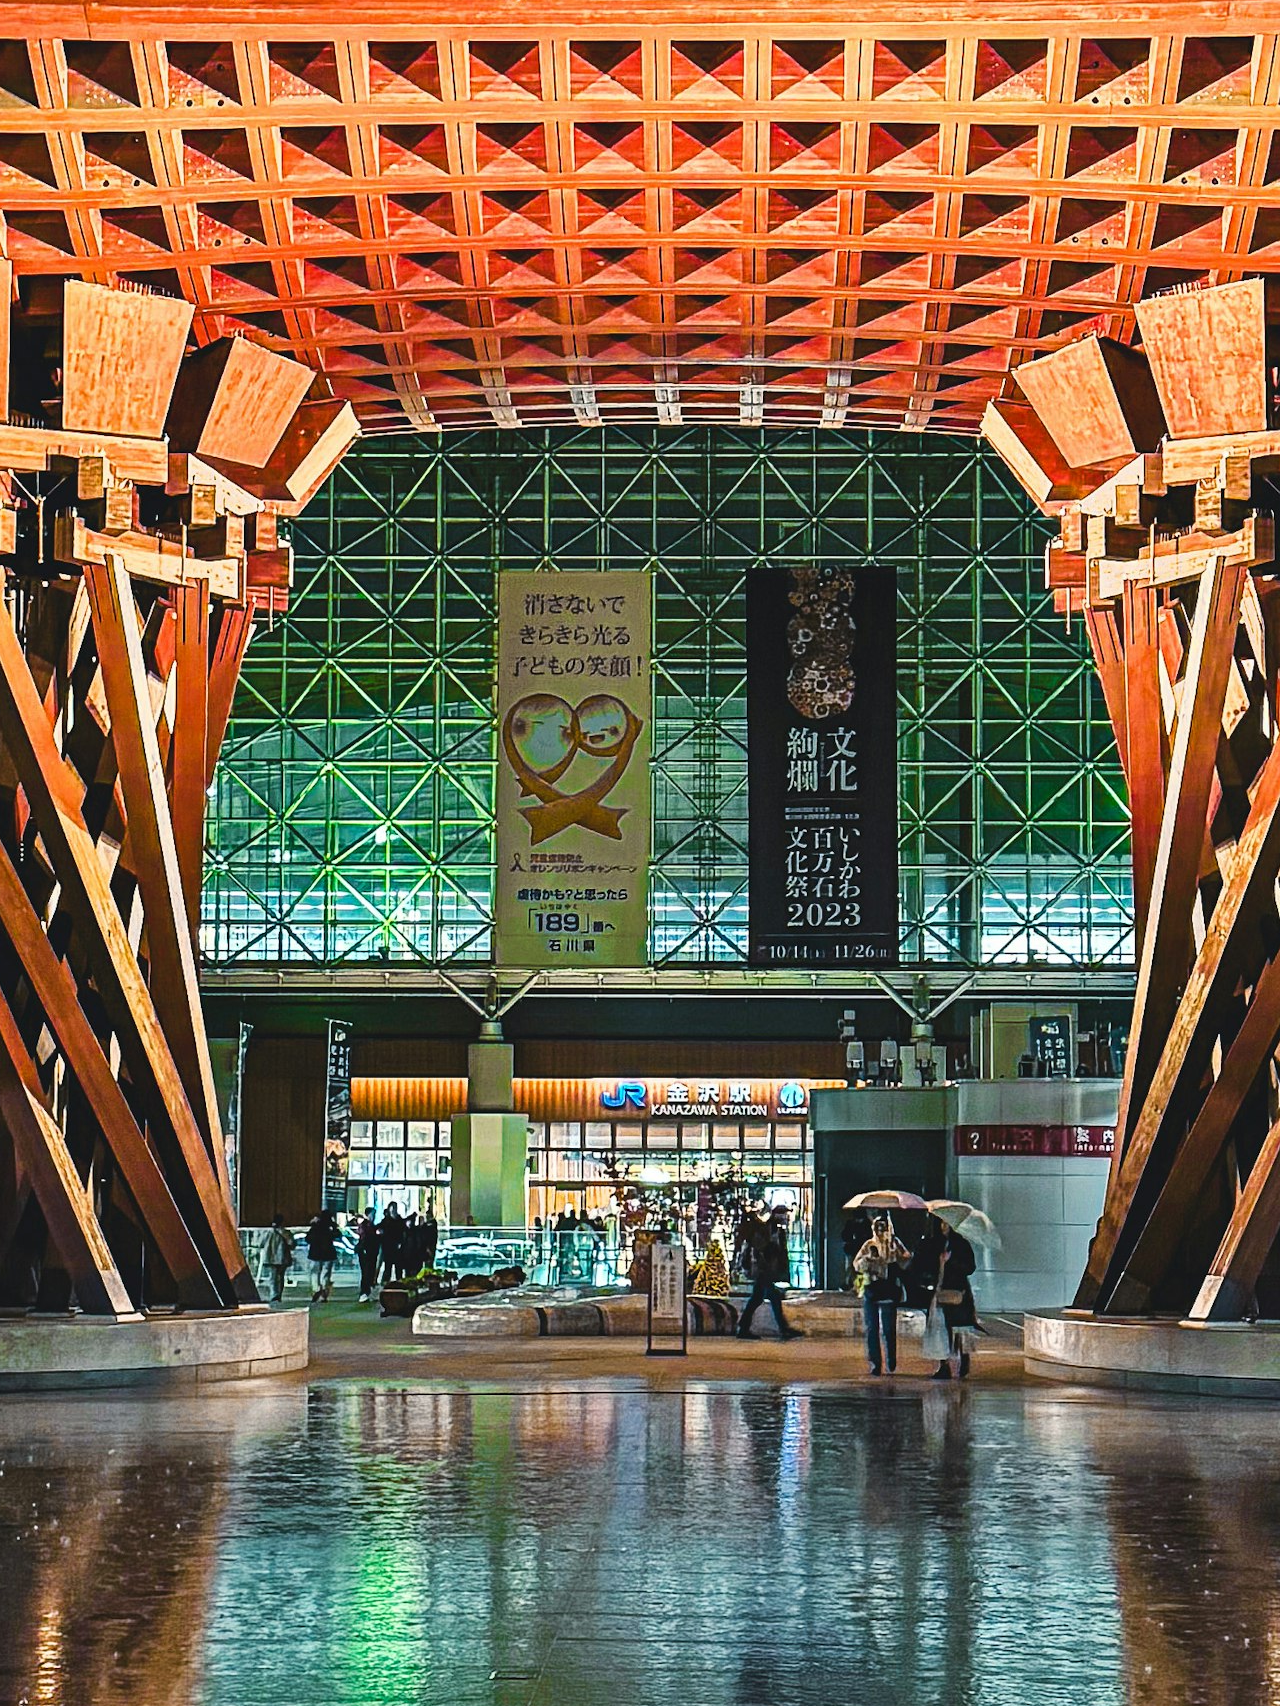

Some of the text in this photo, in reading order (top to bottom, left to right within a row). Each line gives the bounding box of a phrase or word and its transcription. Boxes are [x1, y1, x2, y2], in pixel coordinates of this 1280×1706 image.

[524, 593, 626, 616] 消さないで
[519, 624, 631, 646] きらきら光る
[513, 655, 642, 677] 子どもの笑顔!
[825, 726, 858, 792] 文化
[784, 826, 809, 898] 文化祭
[810, 826, 835, 898] 百万石
[838, 826, 861, 899] いしかわ
[787, 902, 861, 928] 2023
[548, 938, 596, 953] 石川県
[600, 1081, 646, 1108] JR
[666, 1081, 751, 1103] 金沢駅
[650, 1103, 718, 1116] KANAZAWA
[720, 1104, 768, 1116] STATION
